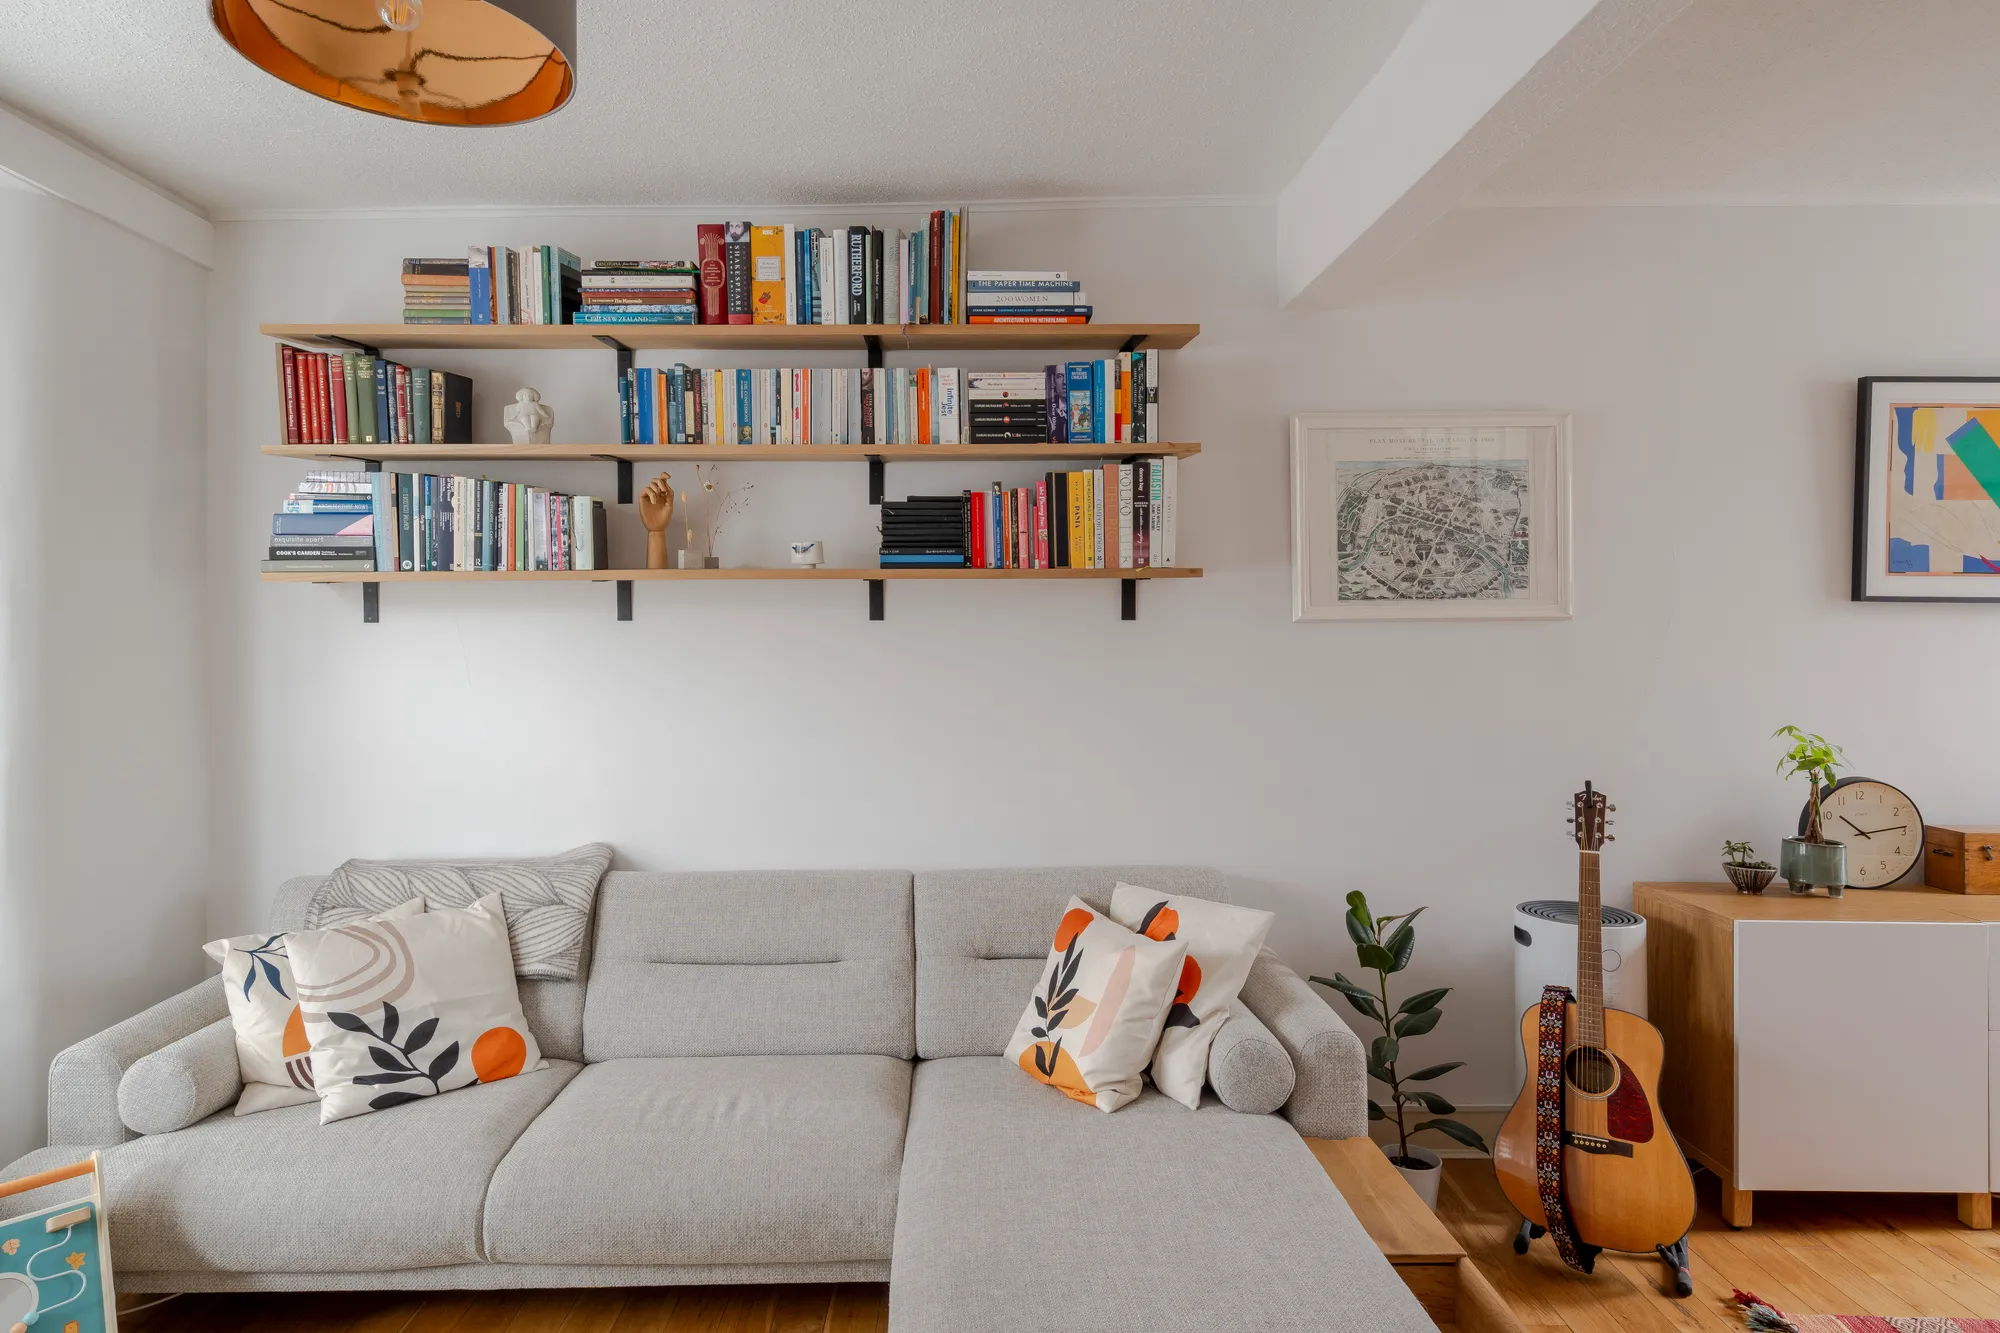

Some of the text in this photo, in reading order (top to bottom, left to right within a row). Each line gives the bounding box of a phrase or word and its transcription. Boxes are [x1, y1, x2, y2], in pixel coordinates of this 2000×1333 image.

[851, 234, 862, 297] RUTHERFORD
[733, 245, 742, 312] SHAKESPEARE
[585, 313, 602, 322] Craft
[1151, 464, 1162, 501] FALASTIN
[1120, 468, 1131, 516] POLPO
[1855, 790, 1865, 800] 12
[1880, 795, 1883, 804] 1
[1837, 797, 1845, 806] 11
[1823, 810, 1833, 820] 10
[1893, 807, 1900, 817] 2
[1901, 827, 1907, 836] 3
[1894, 846, 1901, 855] 4
[1880, 861, 1887, 870] 5
[1859, 866, 1867, 876] 6
